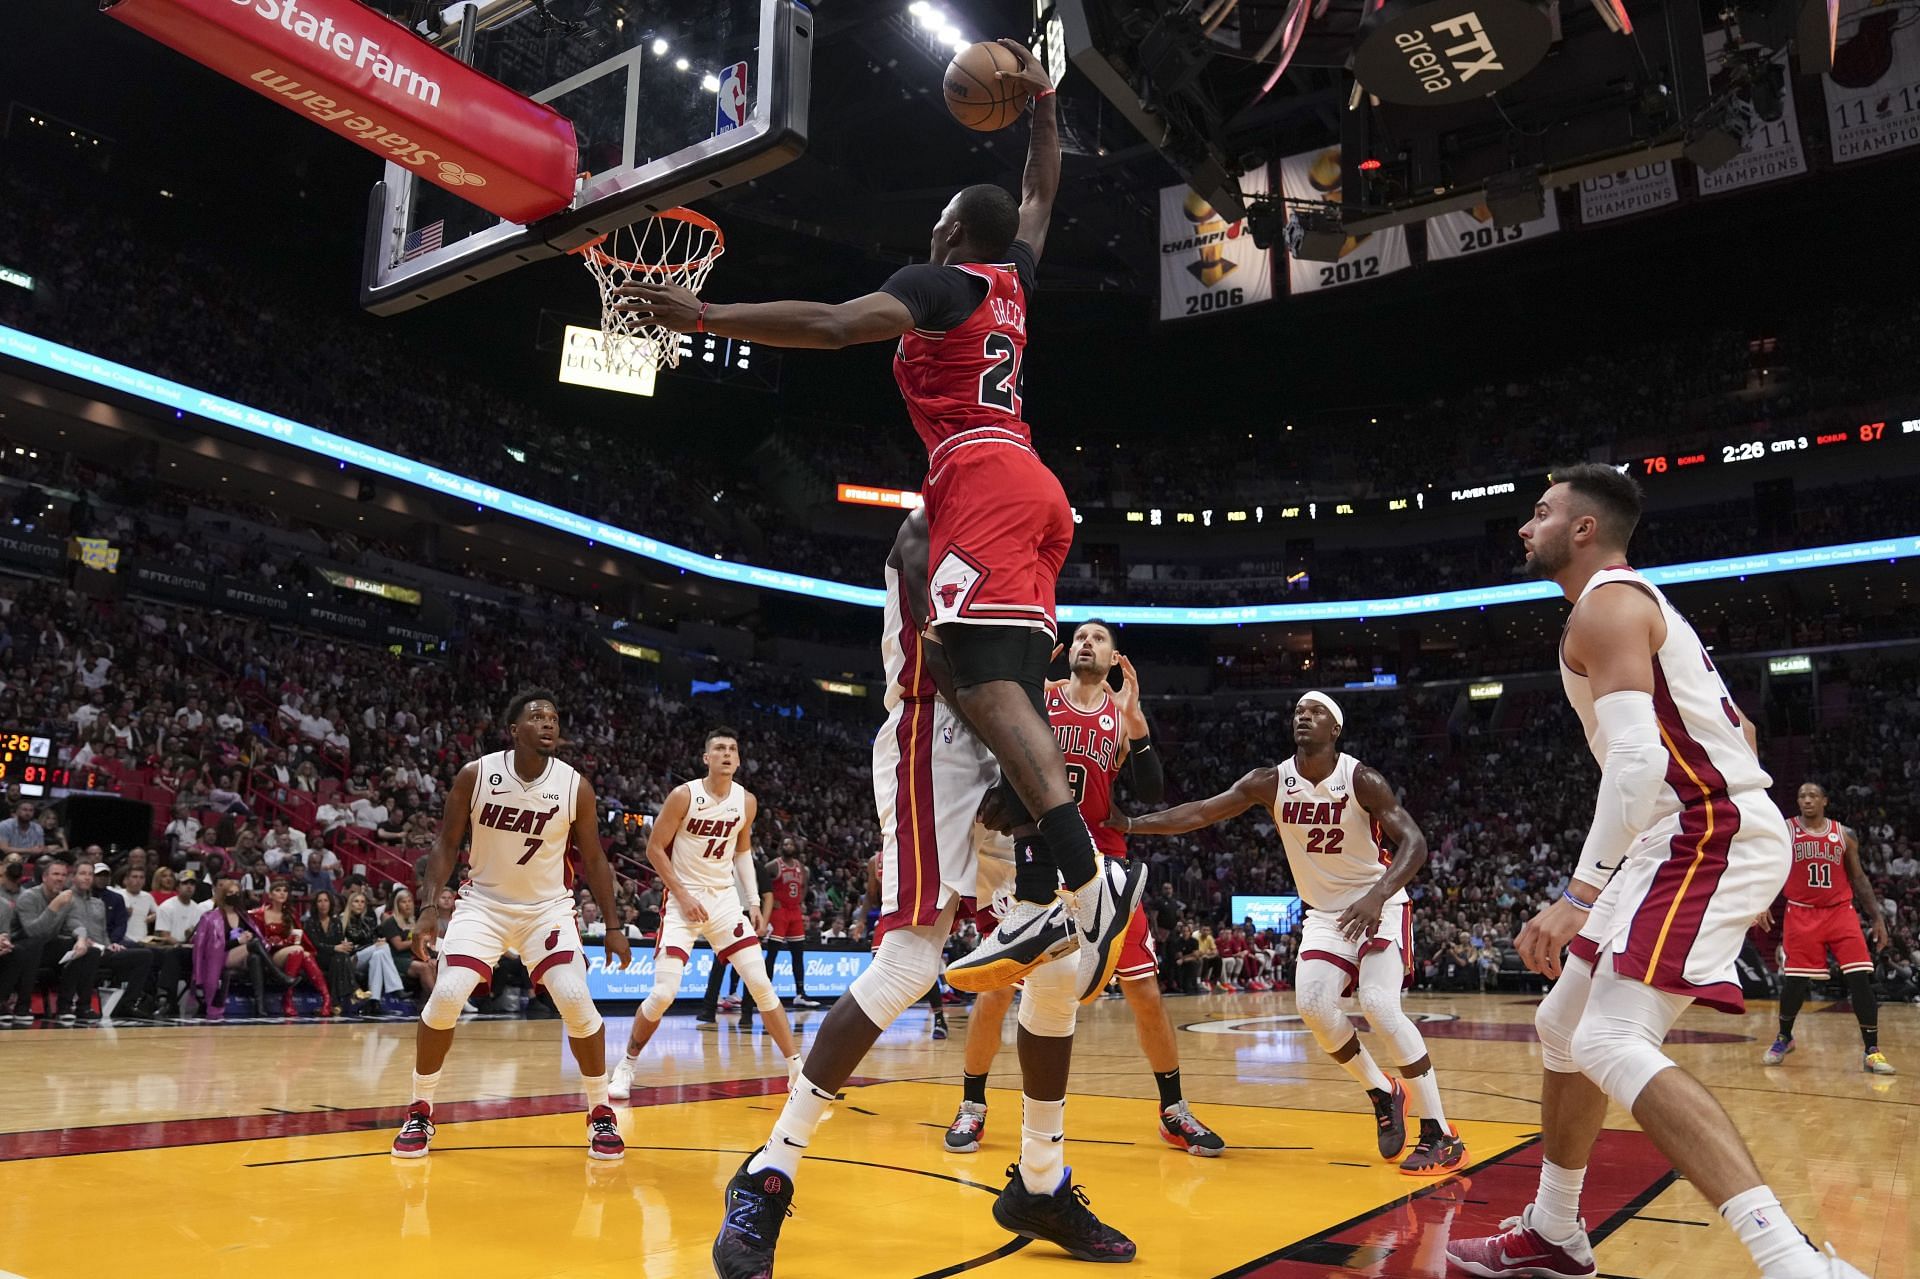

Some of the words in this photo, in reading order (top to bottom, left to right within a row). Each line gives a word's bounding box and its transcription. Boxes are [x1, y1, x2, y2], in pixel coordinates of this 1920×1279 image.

[1431, 11, 1504, 83] FTX
[1394, 29, 1451, 93] arena
[1835, 99, 1869, 129] 11
[1703, 157, 1798, 189] CHAMPIONS
[1587, 187, 1672, 218] CHAMPIONS
[1460, 223, 1524, 253] 2013
[1320, 255, 1380, 287] 2012
[1186, 286, 1244, 316] 2006
[1644, 456, 1668, 475] 76
[1677, 454, 1705, 466] BONUS
[1722, 441, 1765, 463] 2:26
[1771, 439, 1795, 453] QTR
[1797, 437, 1808, 449] 3
[1817, 432, 1847, 445] BONUS
[1860, 423, 1886, 442] 87
[1451, 486, 1486, 501] PLAYER
[1487, 483, 1515, 496] STATS
[1052, 699, 1059, 707] 6
[0, 734, 30, 751] :26
[25, 766, 47, 782] 87
[492, 775, 499, 784] 6
[542, 792, 559, 801] UKG
[1283, 793, 1350, 825] HEAT
[479, 803, 560, 836] HEAT
[686, 816, 740, 838] HEAT
[516, 838, 544, 865] 7
[703, 839, 728, 860] 14
[1307, 828, 1345, 854] 22
[1794, 841, 1843, 865] BULLS
[1808, 863, 1832, 888] 11
[806, 958, 834, 976] Blue
[607, 984, 622, 993] Your
[623, 984, 639, 993] local
